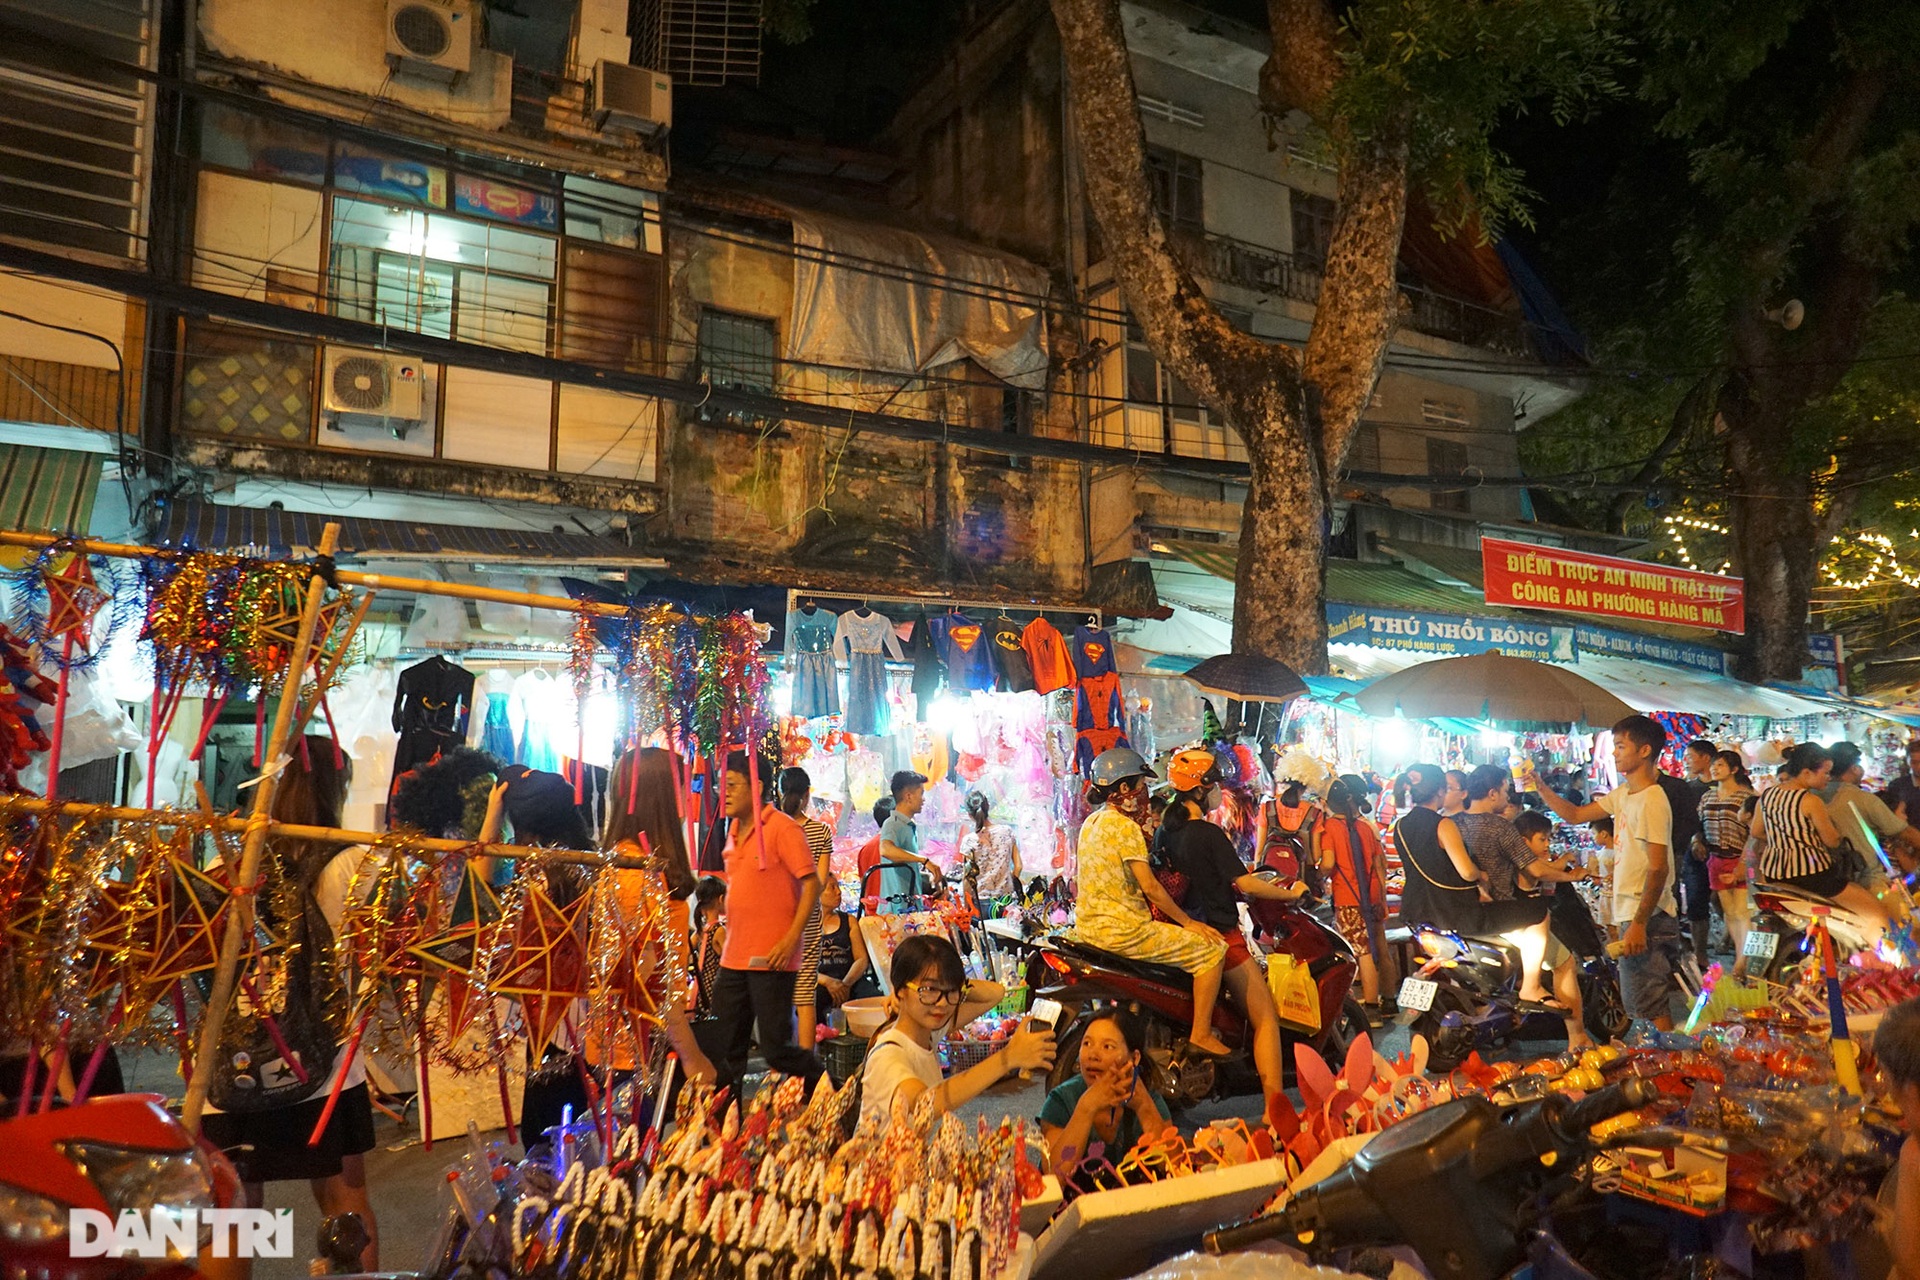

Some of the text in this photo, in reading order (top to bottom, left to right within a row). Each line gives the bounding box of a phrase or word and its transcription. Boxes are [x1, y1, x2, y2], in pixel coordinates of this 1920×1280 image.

[1507, 551, 1552, 577] ĐIỂM
[1556, 560, 1599, 585] TRỰC
[1603, 568, 1625, 587] AN
[1630, 570, 1667, 592] NINH
[1670, 576, 1705, 600] TRẬT
[1511, 580, 1725, 625] CÔNG AN PHƯỜNG HÀNG MÃ
[1369, 616, 1550, 647] THÚ NHỒI BÔNG
